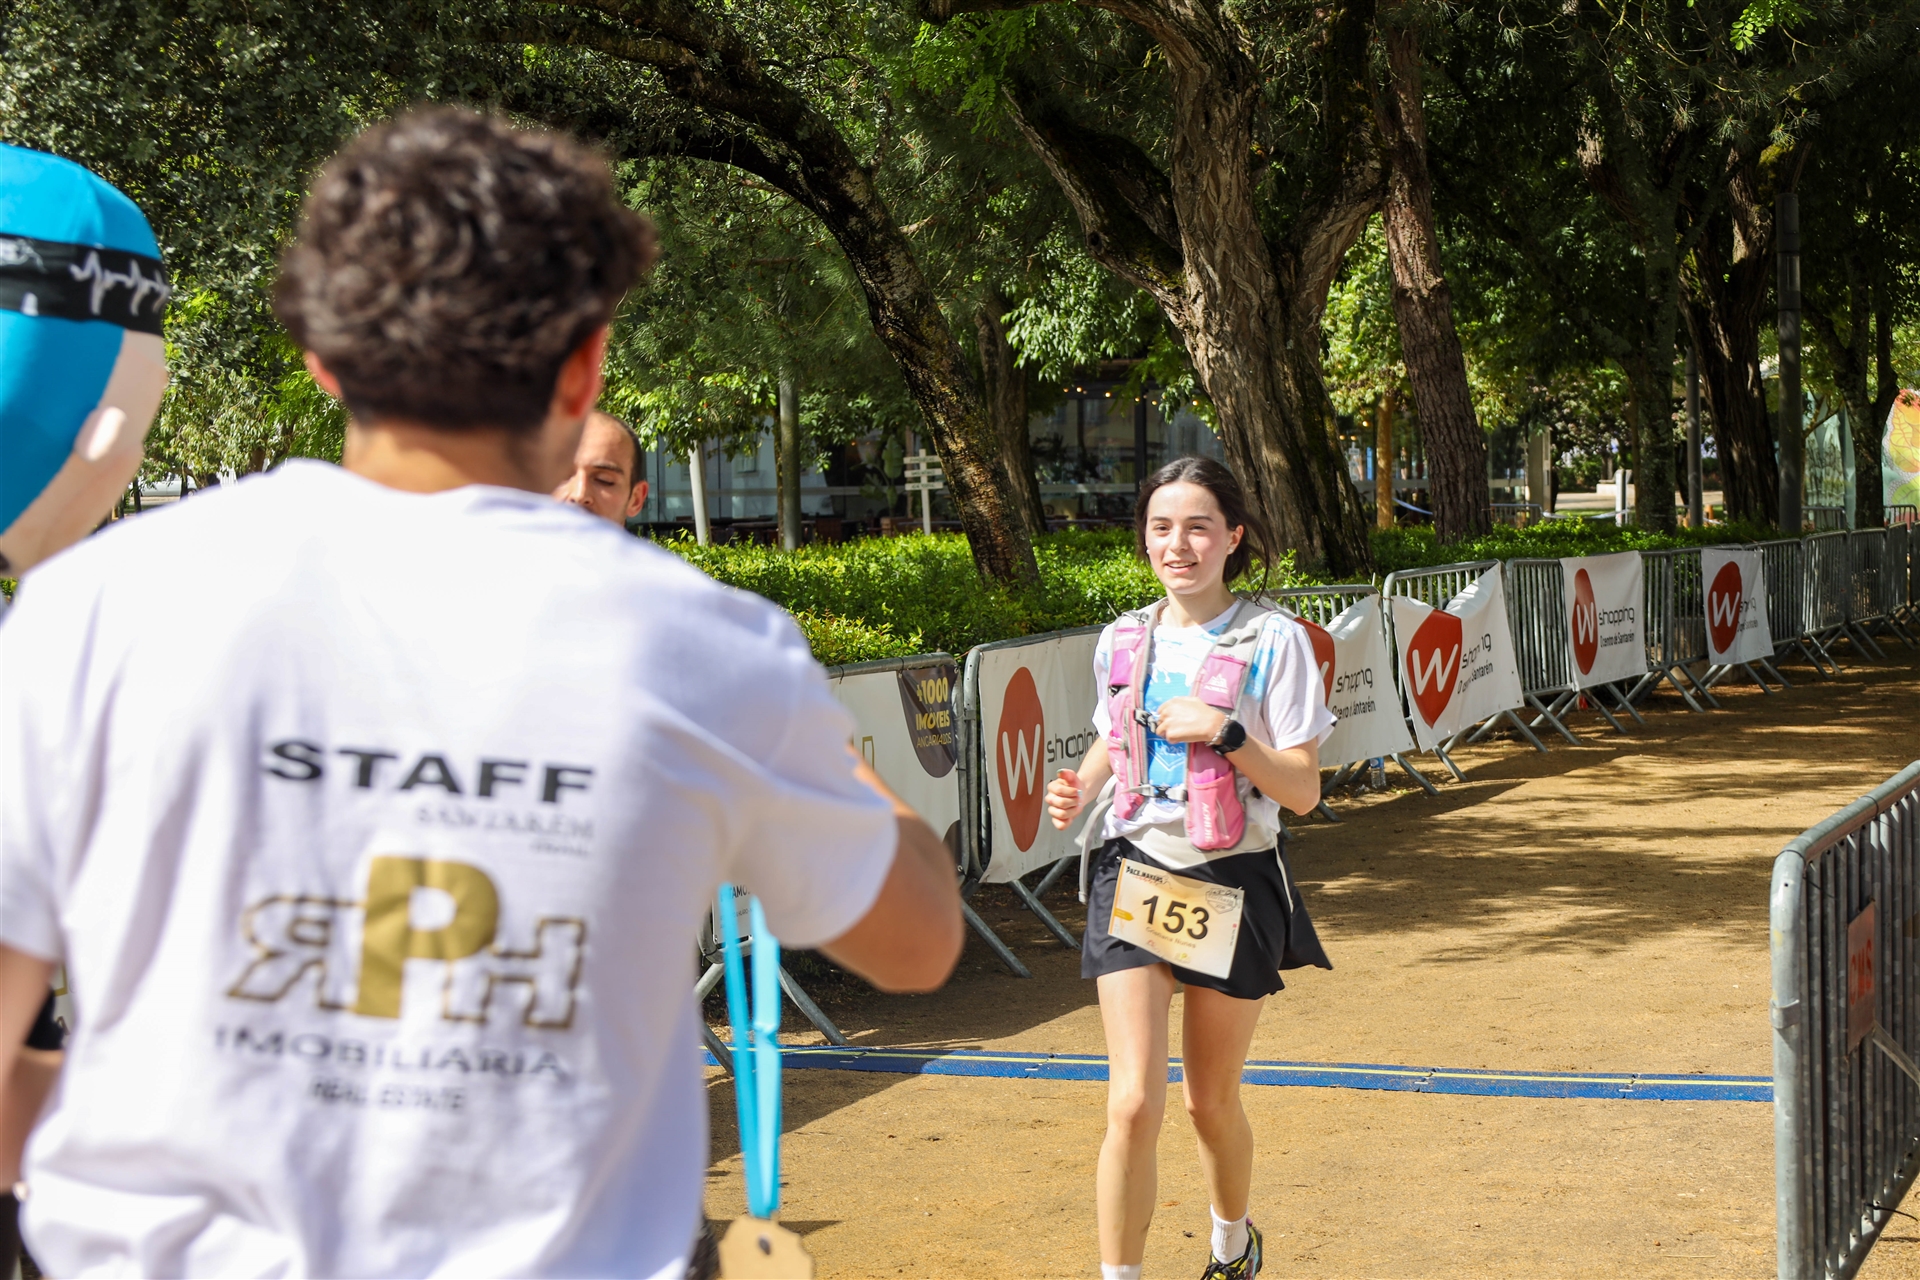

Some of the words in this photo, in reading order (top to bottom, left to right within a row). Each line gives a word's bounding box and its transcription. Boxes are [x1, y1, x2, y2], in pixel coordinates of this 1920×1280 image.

[1599, 606, 1635, 627] shopping
[916, 676, 949, 705] +1000
[1412, 643, 1459, 696] W
[915, 707, 951, 731] IMÓVEIS
[263, 738, 596, 805] STAFF
[1001, 723, 1042, 801] W
[1142, 894, 1210, 941] 153
